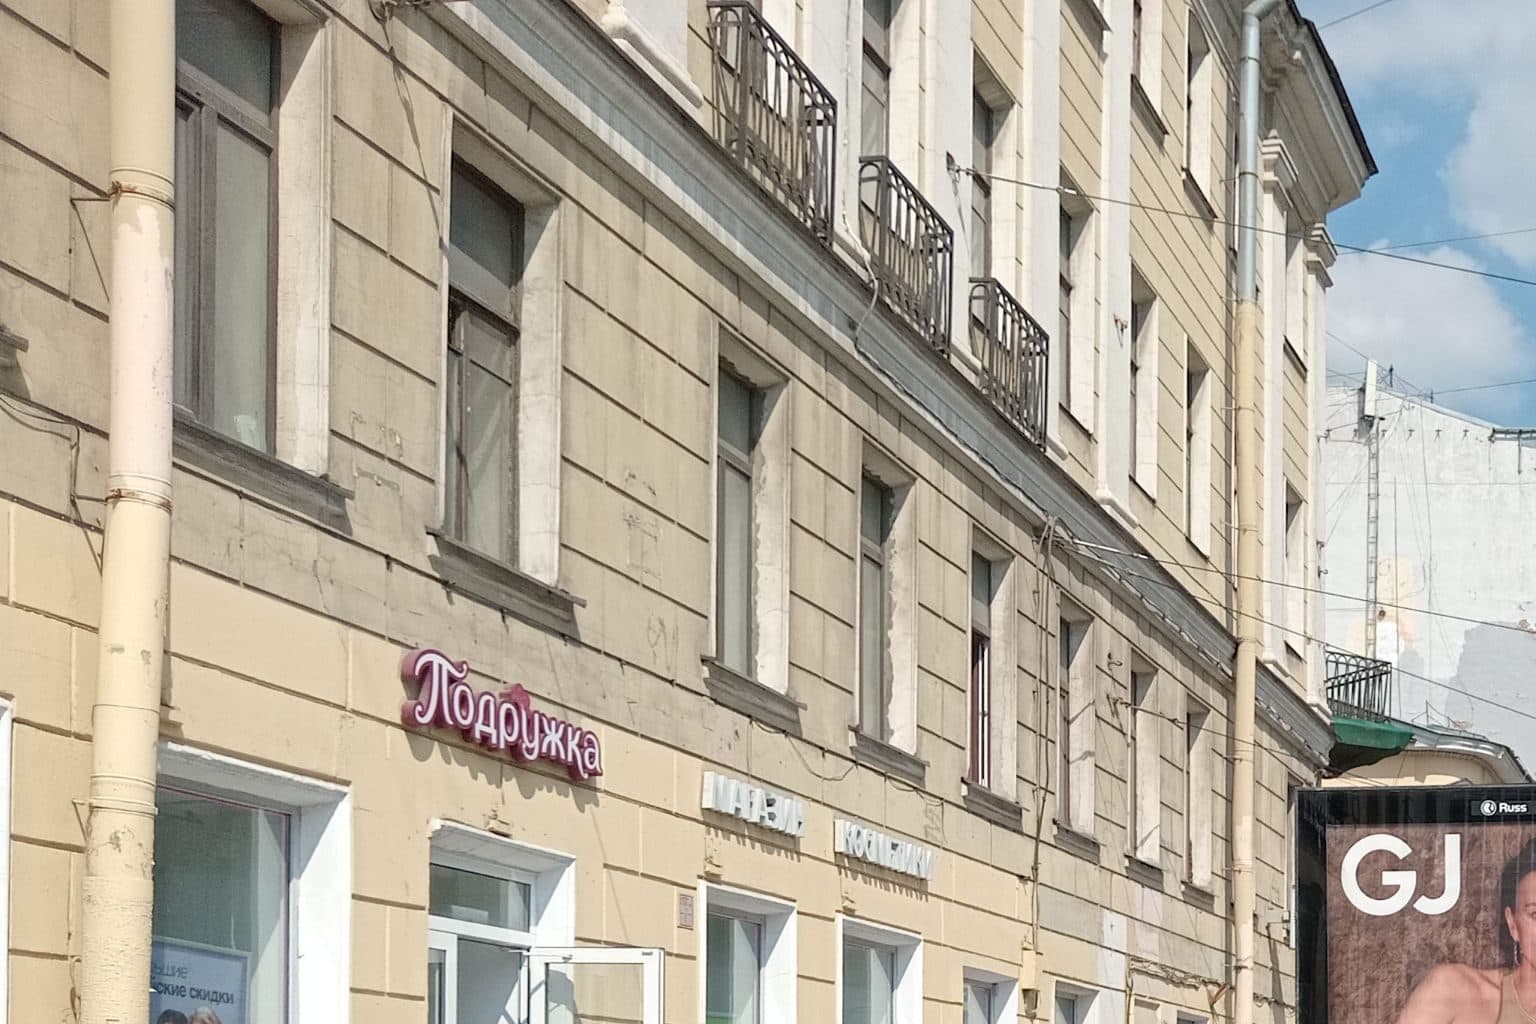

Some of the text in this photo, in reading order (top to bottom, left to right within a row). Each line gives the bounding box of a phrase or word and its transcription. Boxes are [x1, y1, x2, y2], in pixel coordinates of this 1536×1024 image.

[410, 650, 603, 780] Подружка
[1499, 802, 1527, 813] Russ
[1341, 833, 1461, 916] GJ
[189, 986, 234, 1005] скидки
